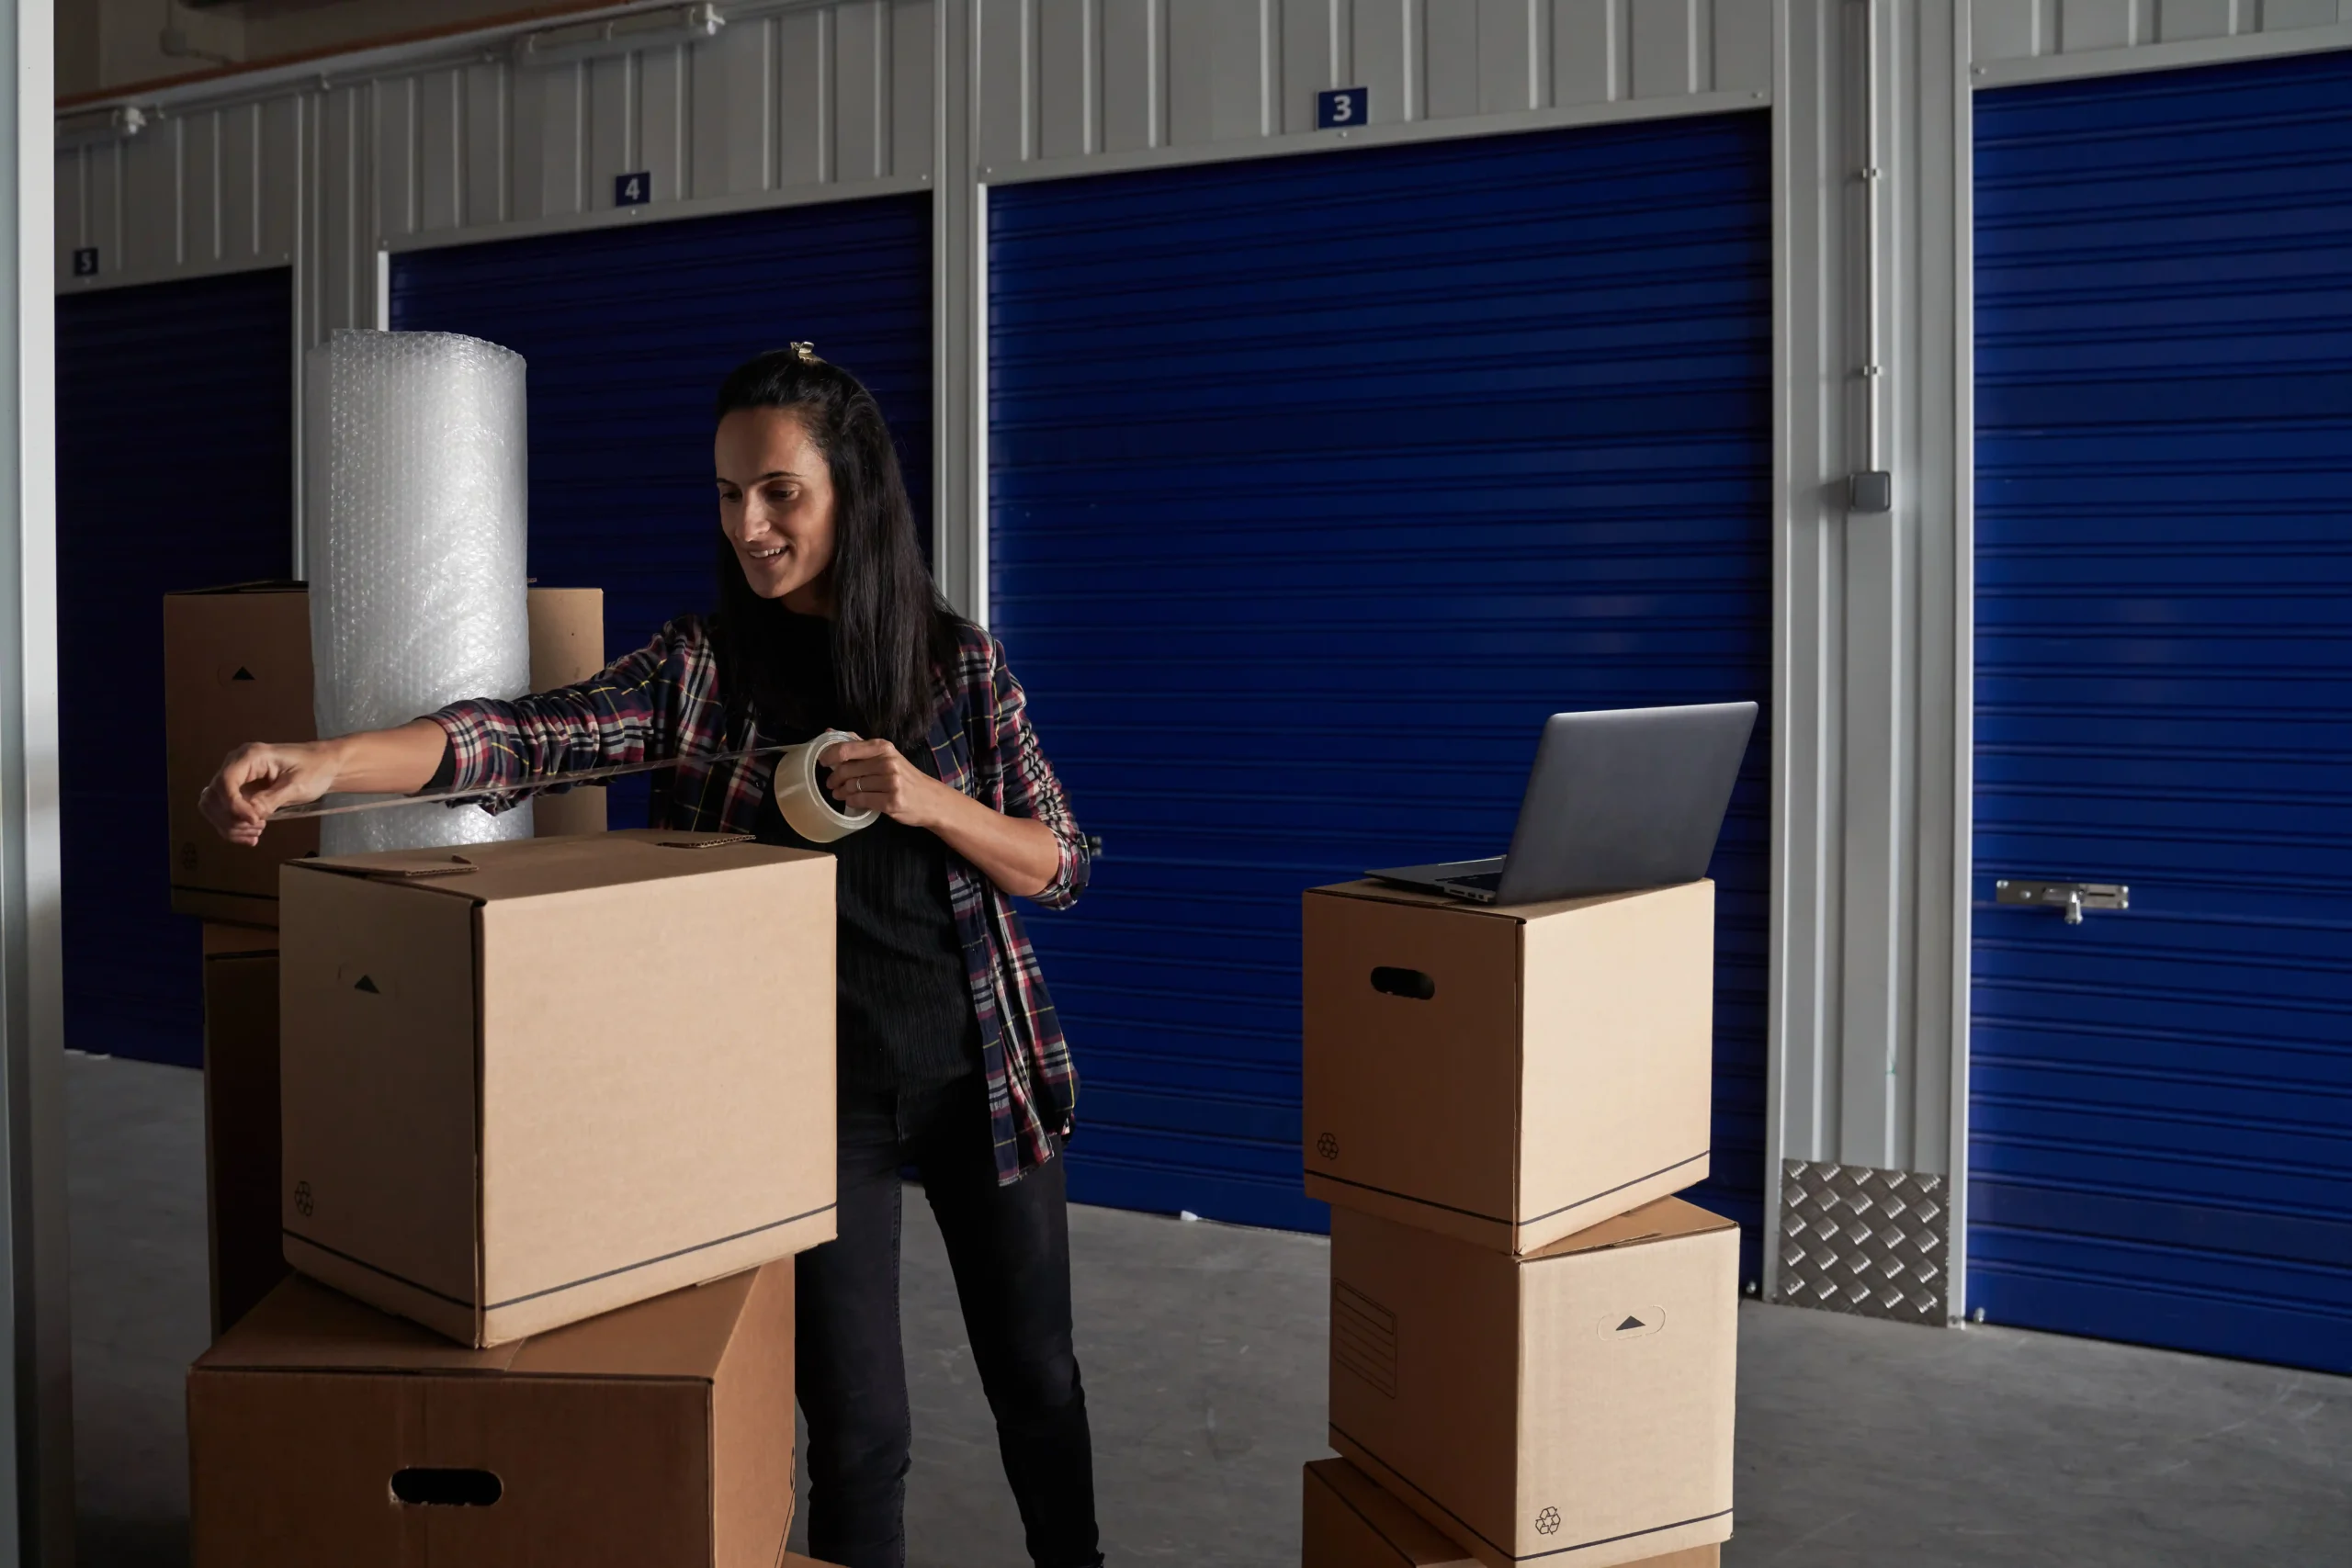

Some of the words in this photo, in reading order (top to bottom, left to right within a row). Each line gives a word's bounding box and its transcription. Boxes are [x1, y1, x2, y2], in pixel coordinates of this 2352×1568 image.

[1333, 94, 1351, 121] 3
[625, 177, 640, 200] 4
[81, 252, 92, 273] 5
